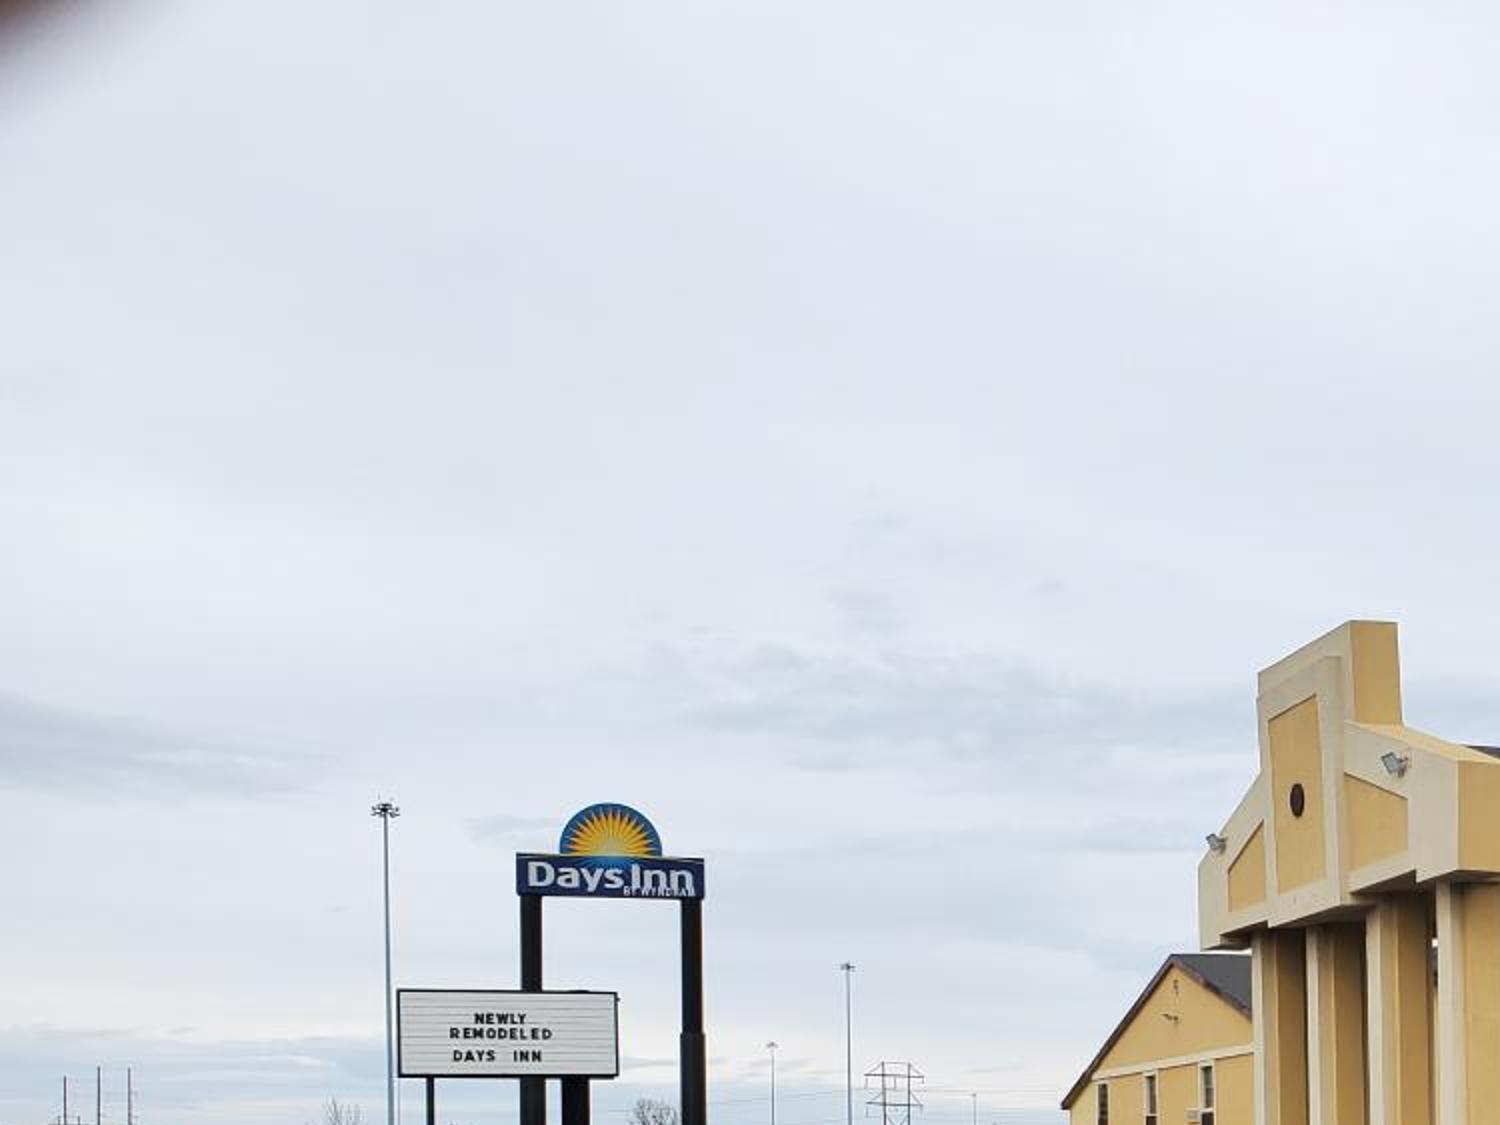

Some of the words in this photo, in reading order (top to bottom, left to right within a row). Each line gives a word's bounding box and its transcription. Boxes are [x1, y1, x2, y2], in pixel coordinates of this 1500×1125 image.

[527, 861, 624, 893] Days
[631, 863, 694, 890] Inn
[474, 1012, 527, 1025] NEWLY
[449, 1027, 552, 1040] REMODELED
[453, 1050, 496, 1062] DAYS
[513, 1050, 542, 1062] INN
